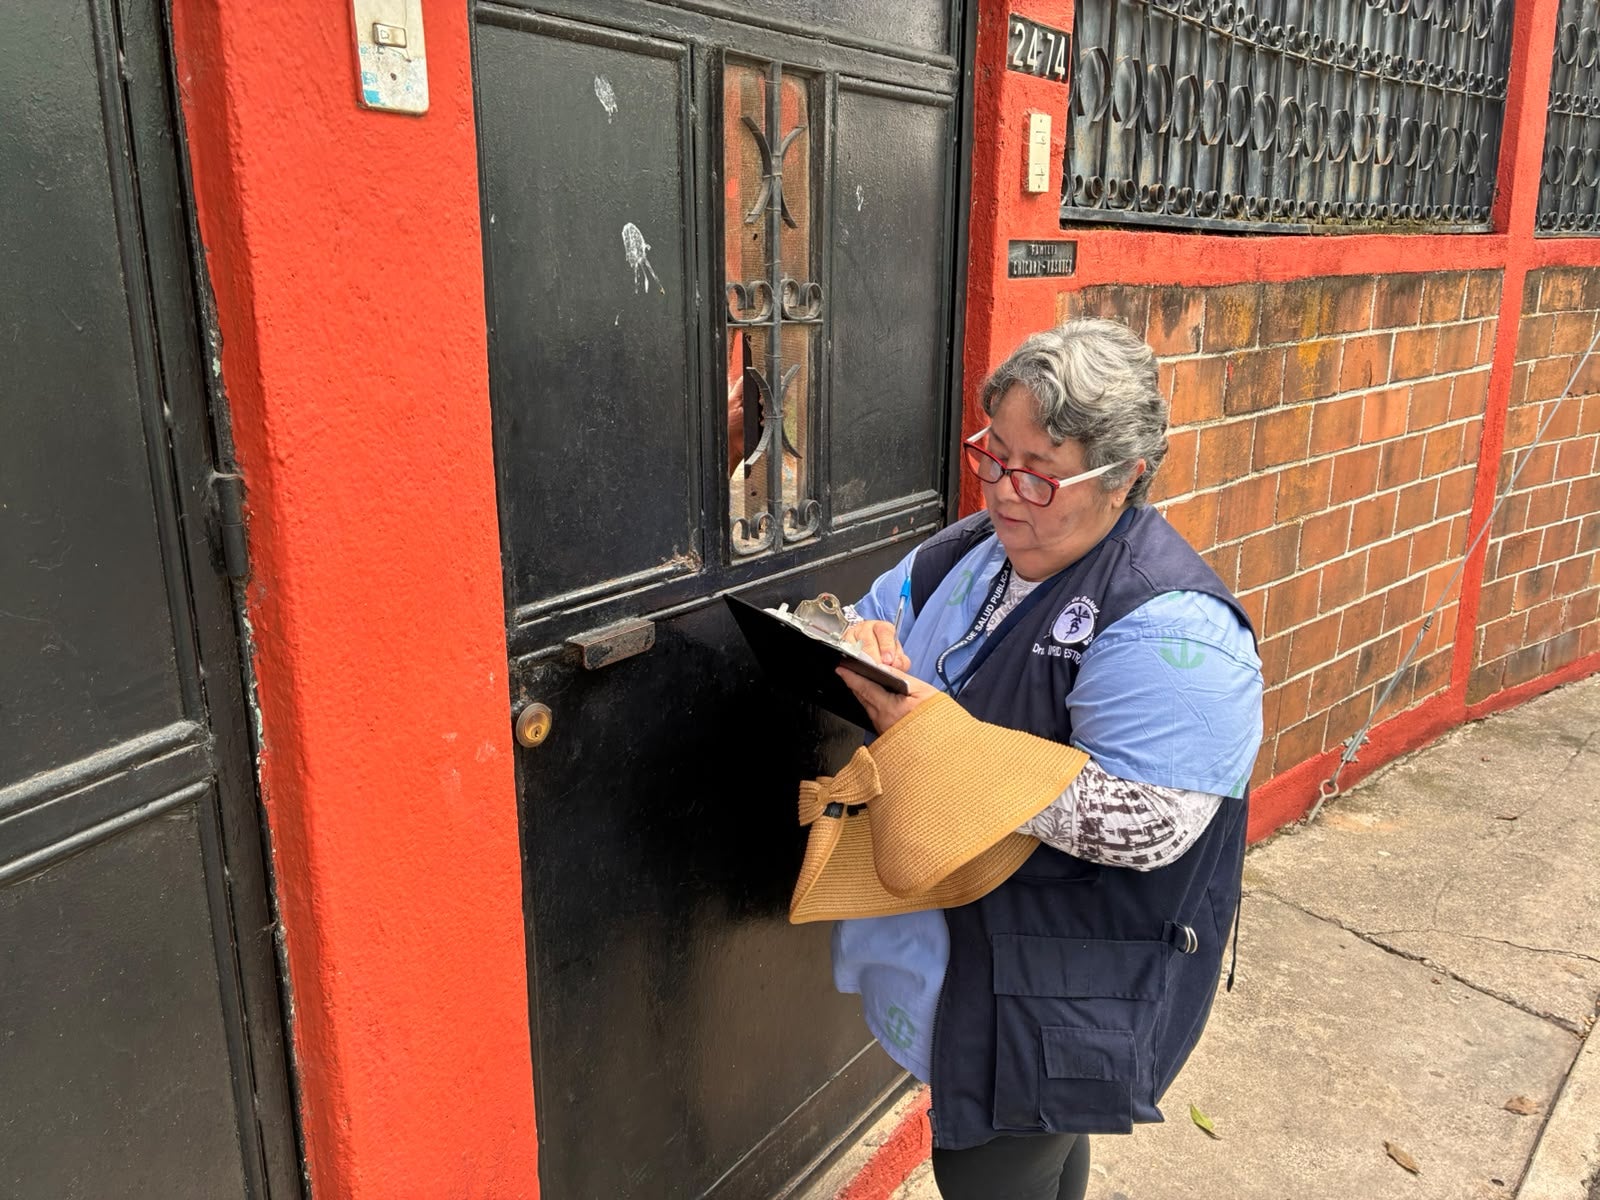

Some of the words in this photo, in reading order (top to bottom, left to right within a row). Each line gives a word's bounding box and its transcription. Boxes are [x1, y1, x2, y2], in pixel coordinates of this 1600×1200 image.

[966, 630, 979, 641] DE
[974, 604, 995, 632] SALUD
[990, 569, 1010, 605] PUBLICA
[1081, 595, 1100, 614] Salud
[1063, 648, 1082, 665] ESTR
